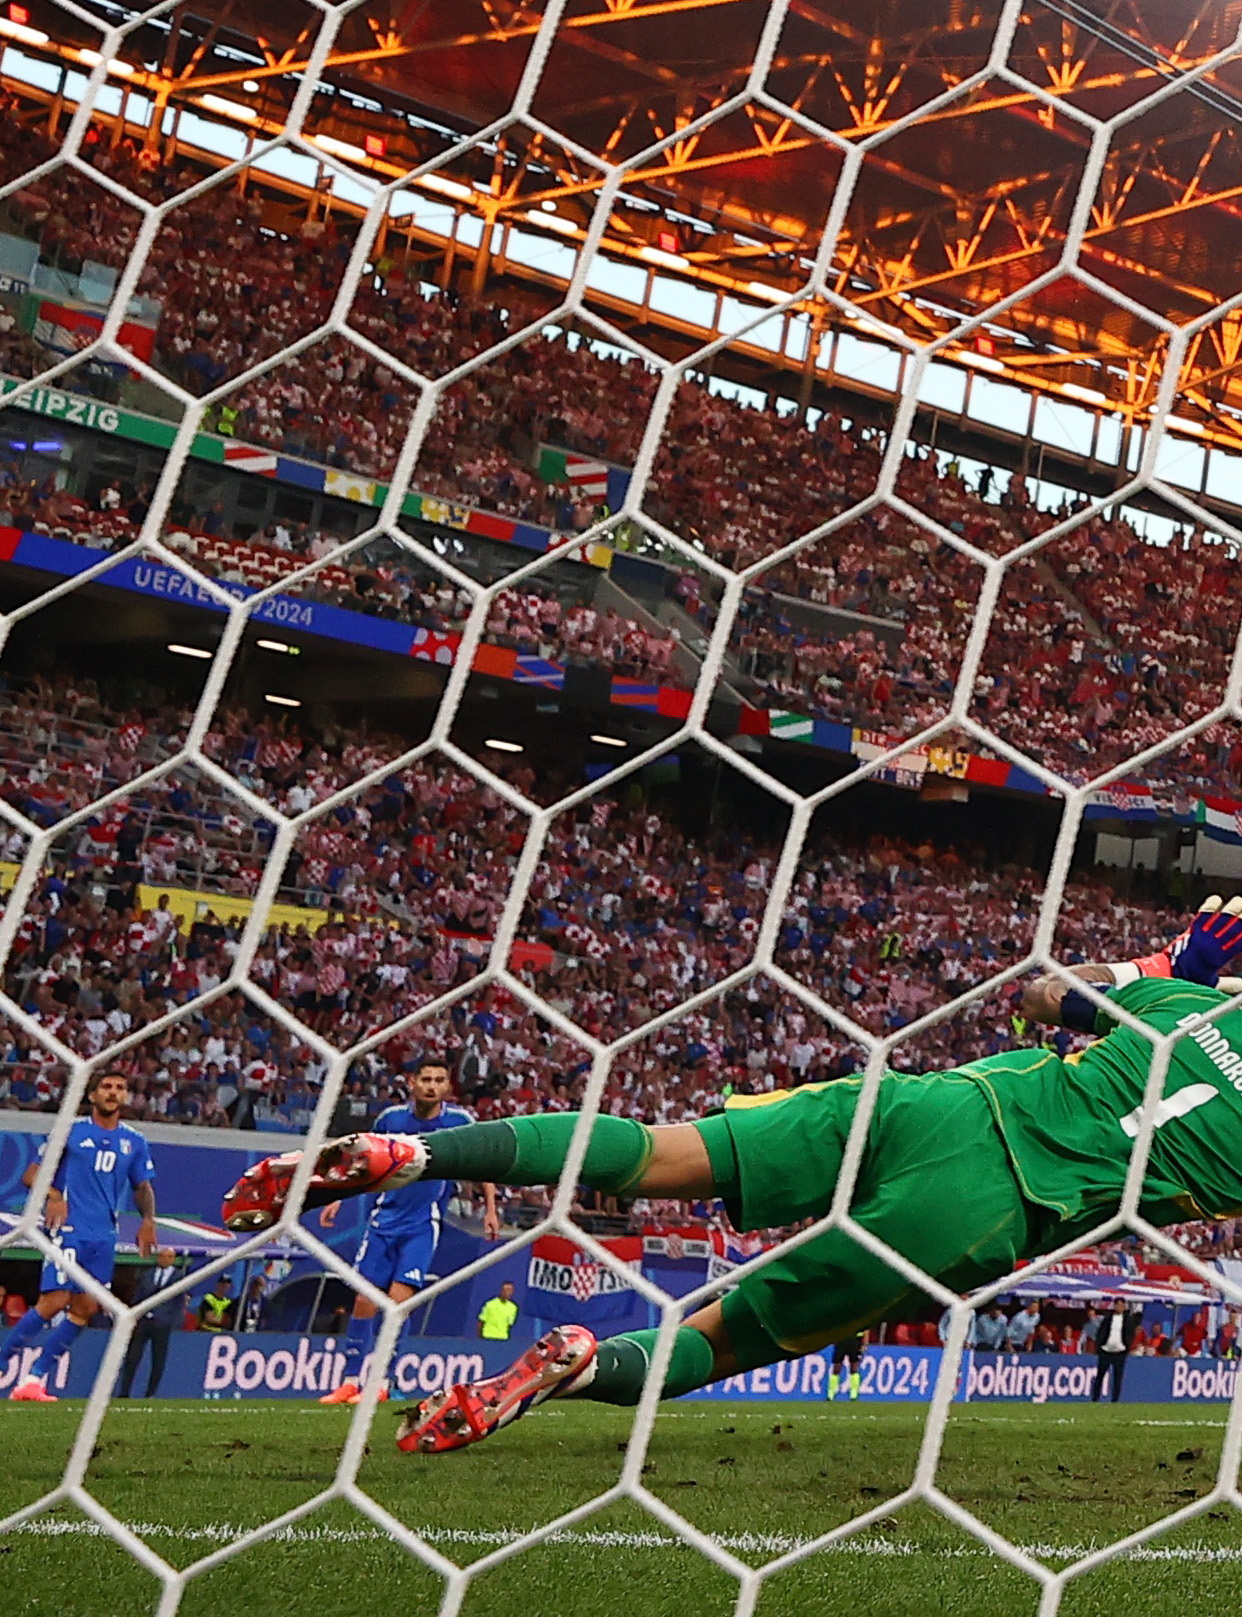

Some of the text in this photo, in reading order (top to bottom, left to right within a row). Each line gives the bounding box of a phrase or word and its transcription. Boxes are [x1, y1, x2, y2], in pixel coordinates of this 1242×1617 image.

[7, 388, 119, 432] EIPZIG
[94, 1150, 117, 1173] 10
[858, 1356, 929, 1396] 2024
